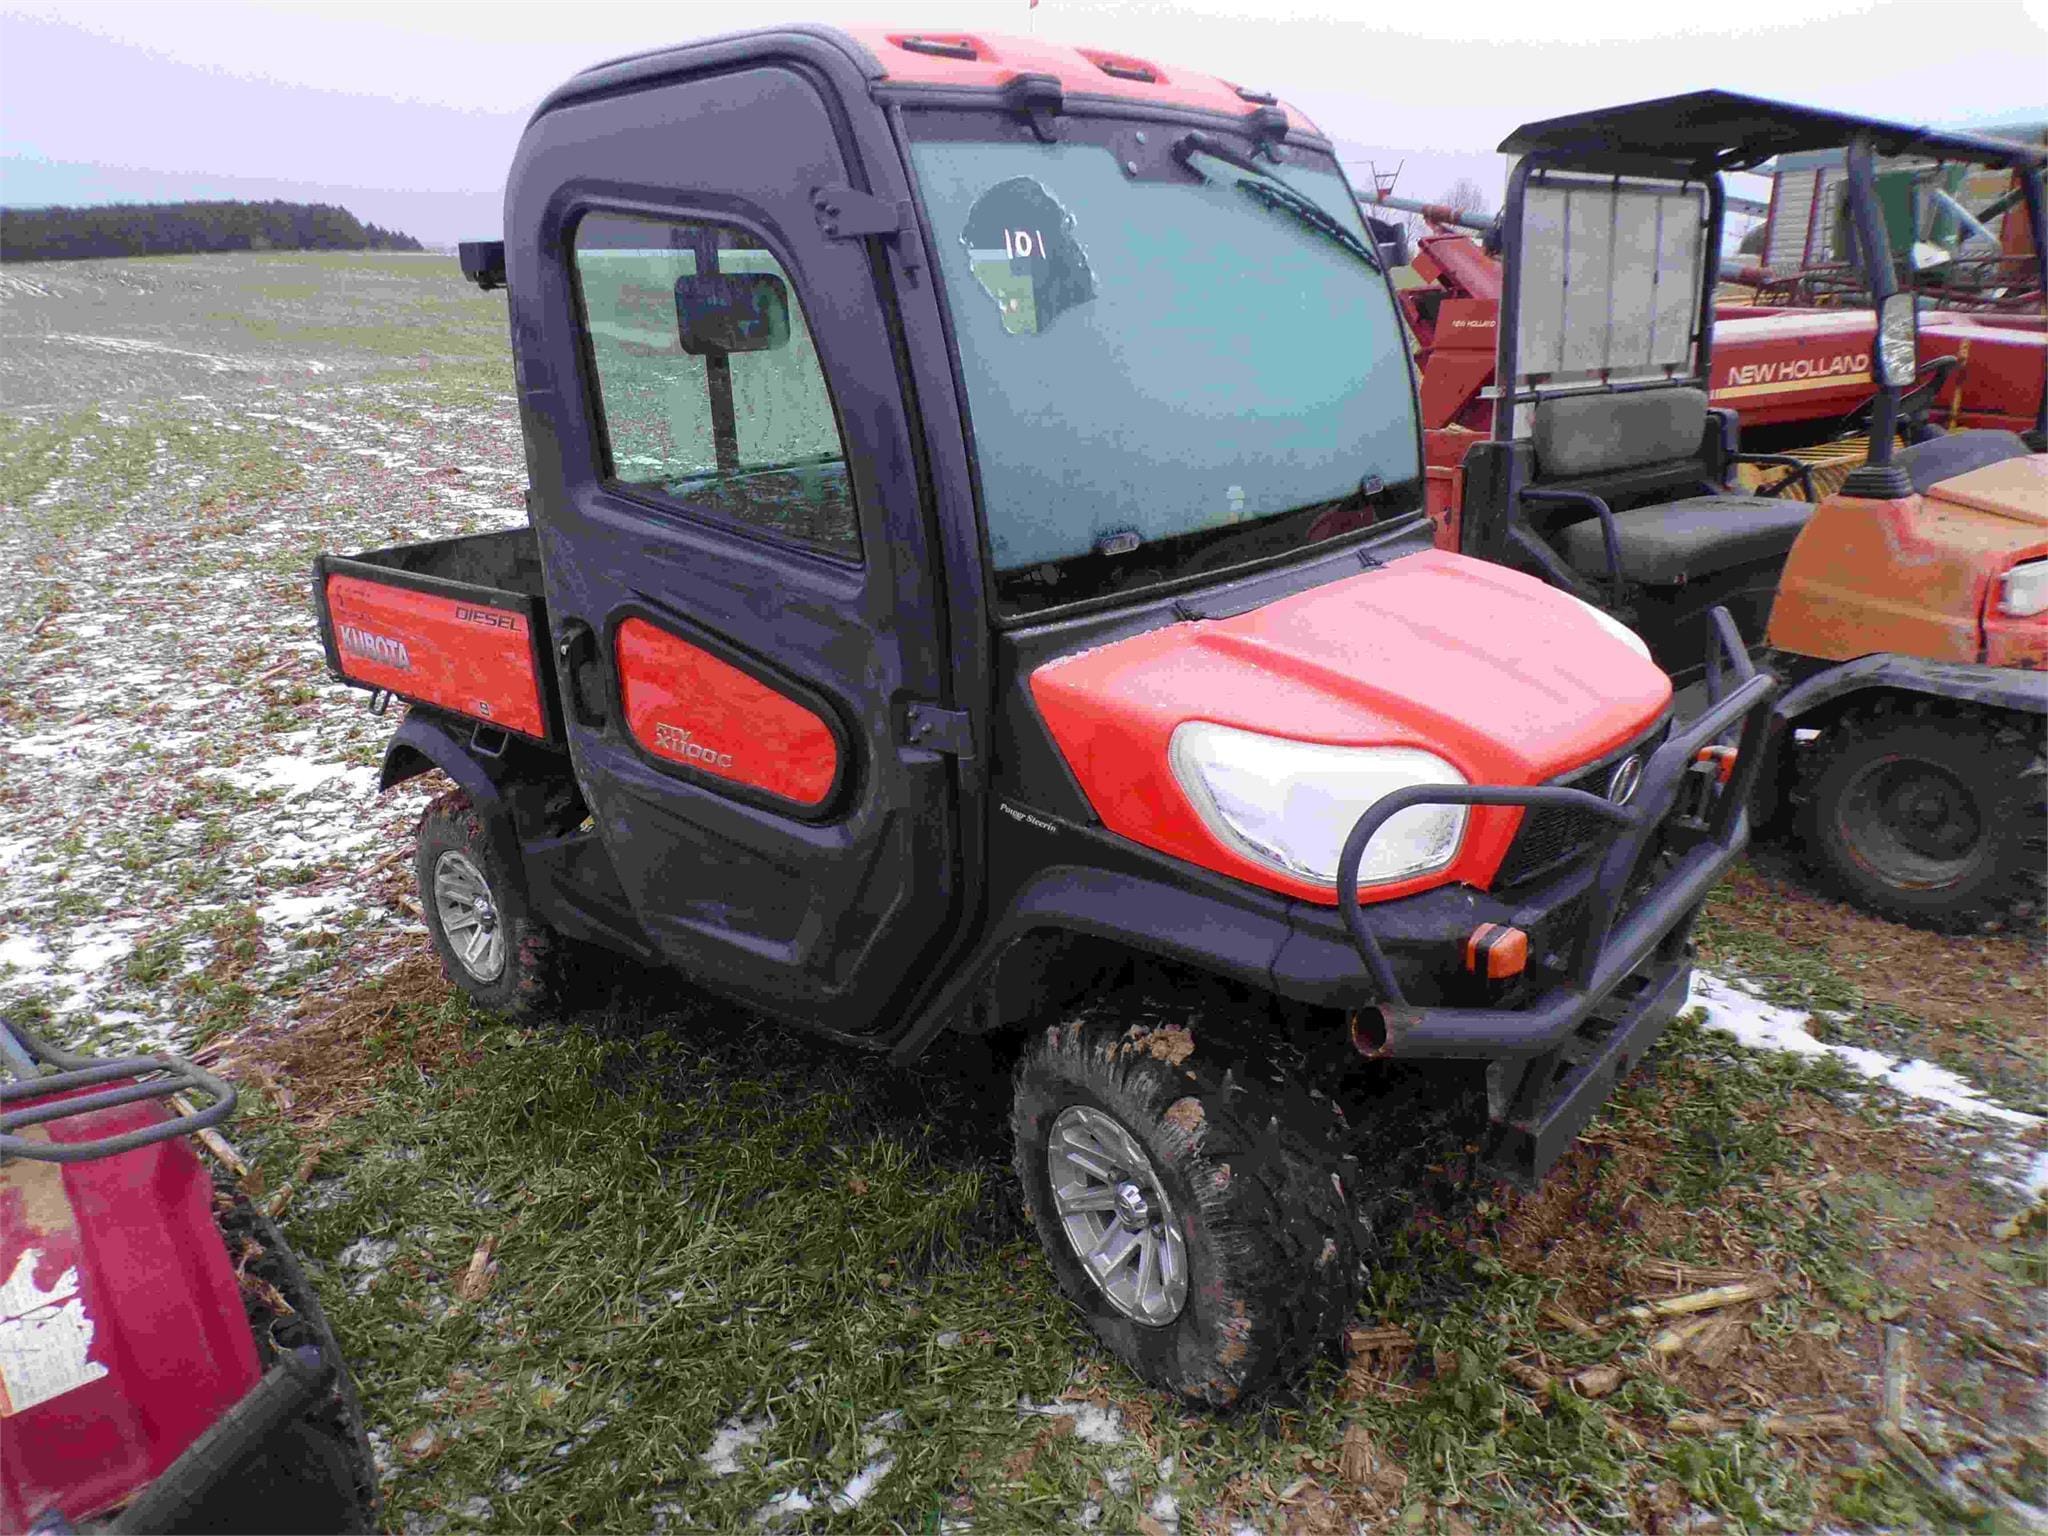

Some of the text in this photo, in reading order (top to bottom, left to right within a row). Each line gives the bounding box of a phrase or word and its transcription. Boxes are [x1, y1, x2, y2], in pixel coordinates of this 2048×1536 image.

[1004, 228, 1047, 260] 101
[1728, 354, 1870, 386] NEW HOLLAND
[456, 607, 522, 631] DIESEL
[340, 625, 413, 671] KUBOTA
